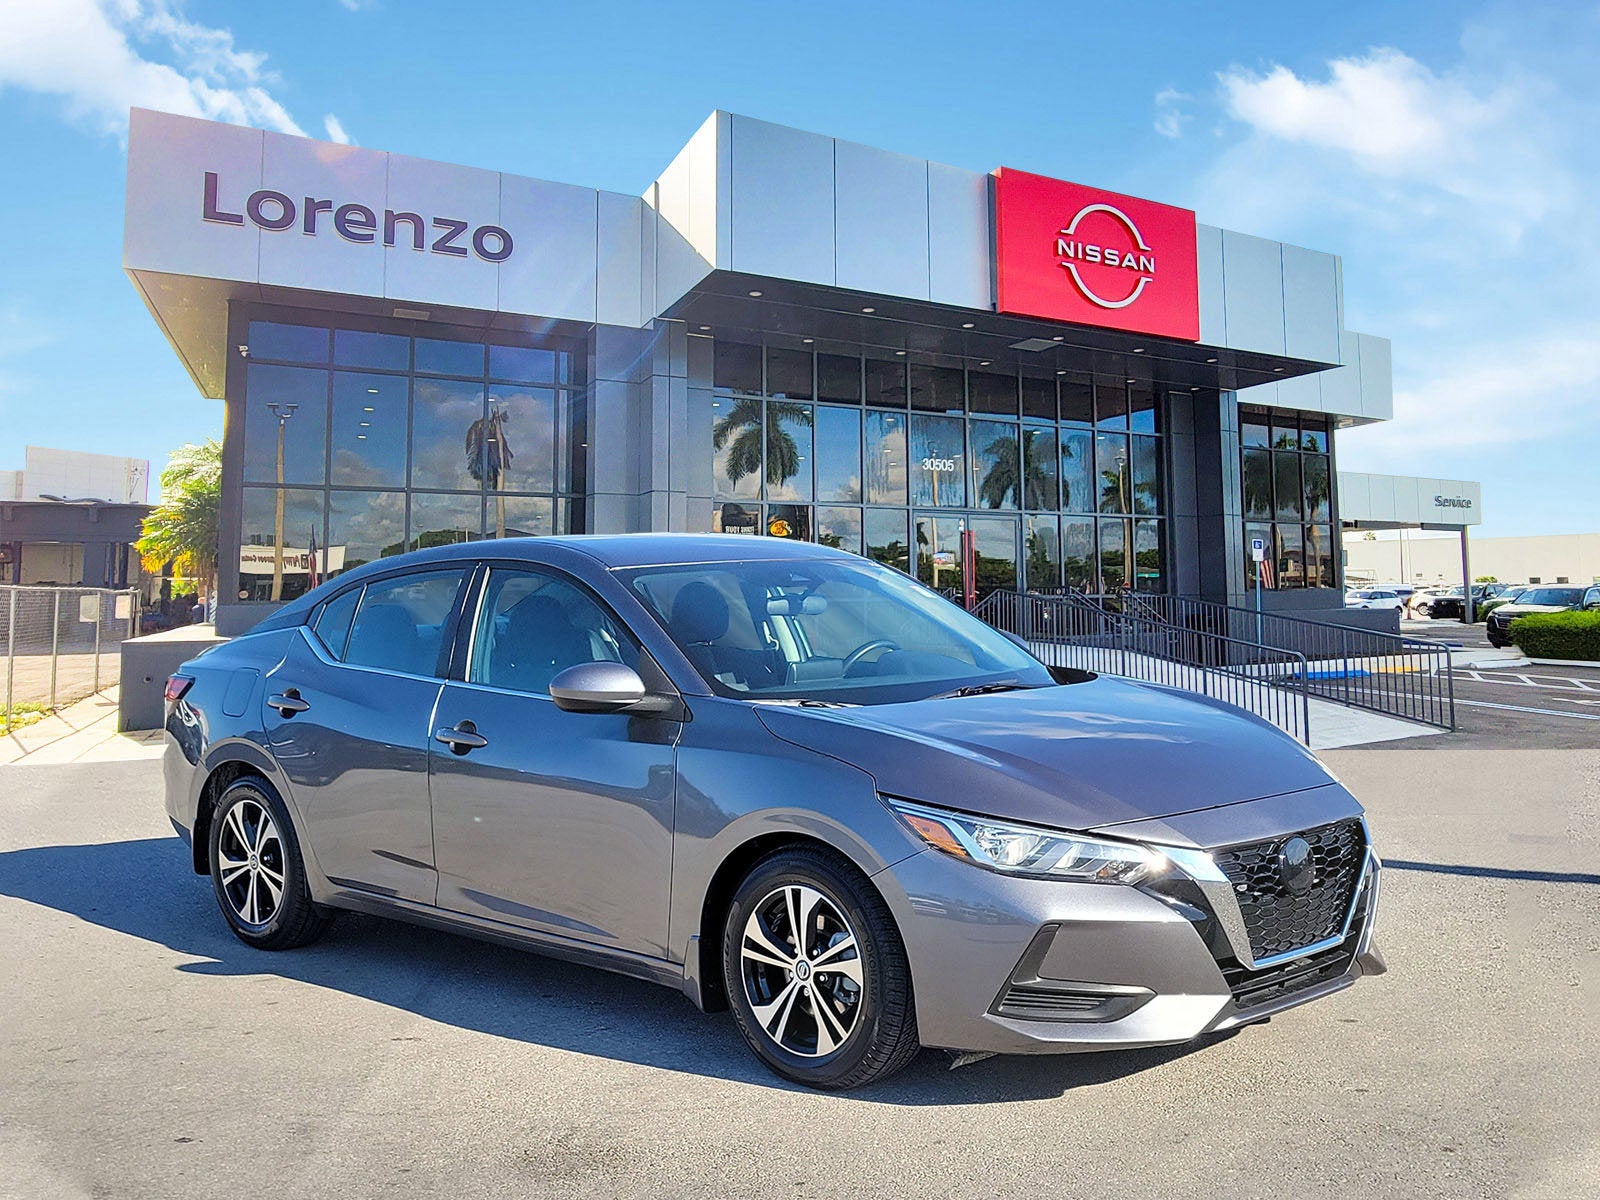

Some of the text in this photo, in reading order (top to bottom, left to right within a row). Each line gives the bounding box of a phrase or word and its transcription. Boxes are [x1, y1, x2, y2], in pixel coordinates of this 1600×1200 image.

[202, 170, 514, 263] Lorenzo
[1057, 238, 1155, 273] NISSAN
[922, 457, 955, 472] 30505
[1434, 495, 1472, 508] Service
[864, 936, 878, 1004] YOKOHAMA
